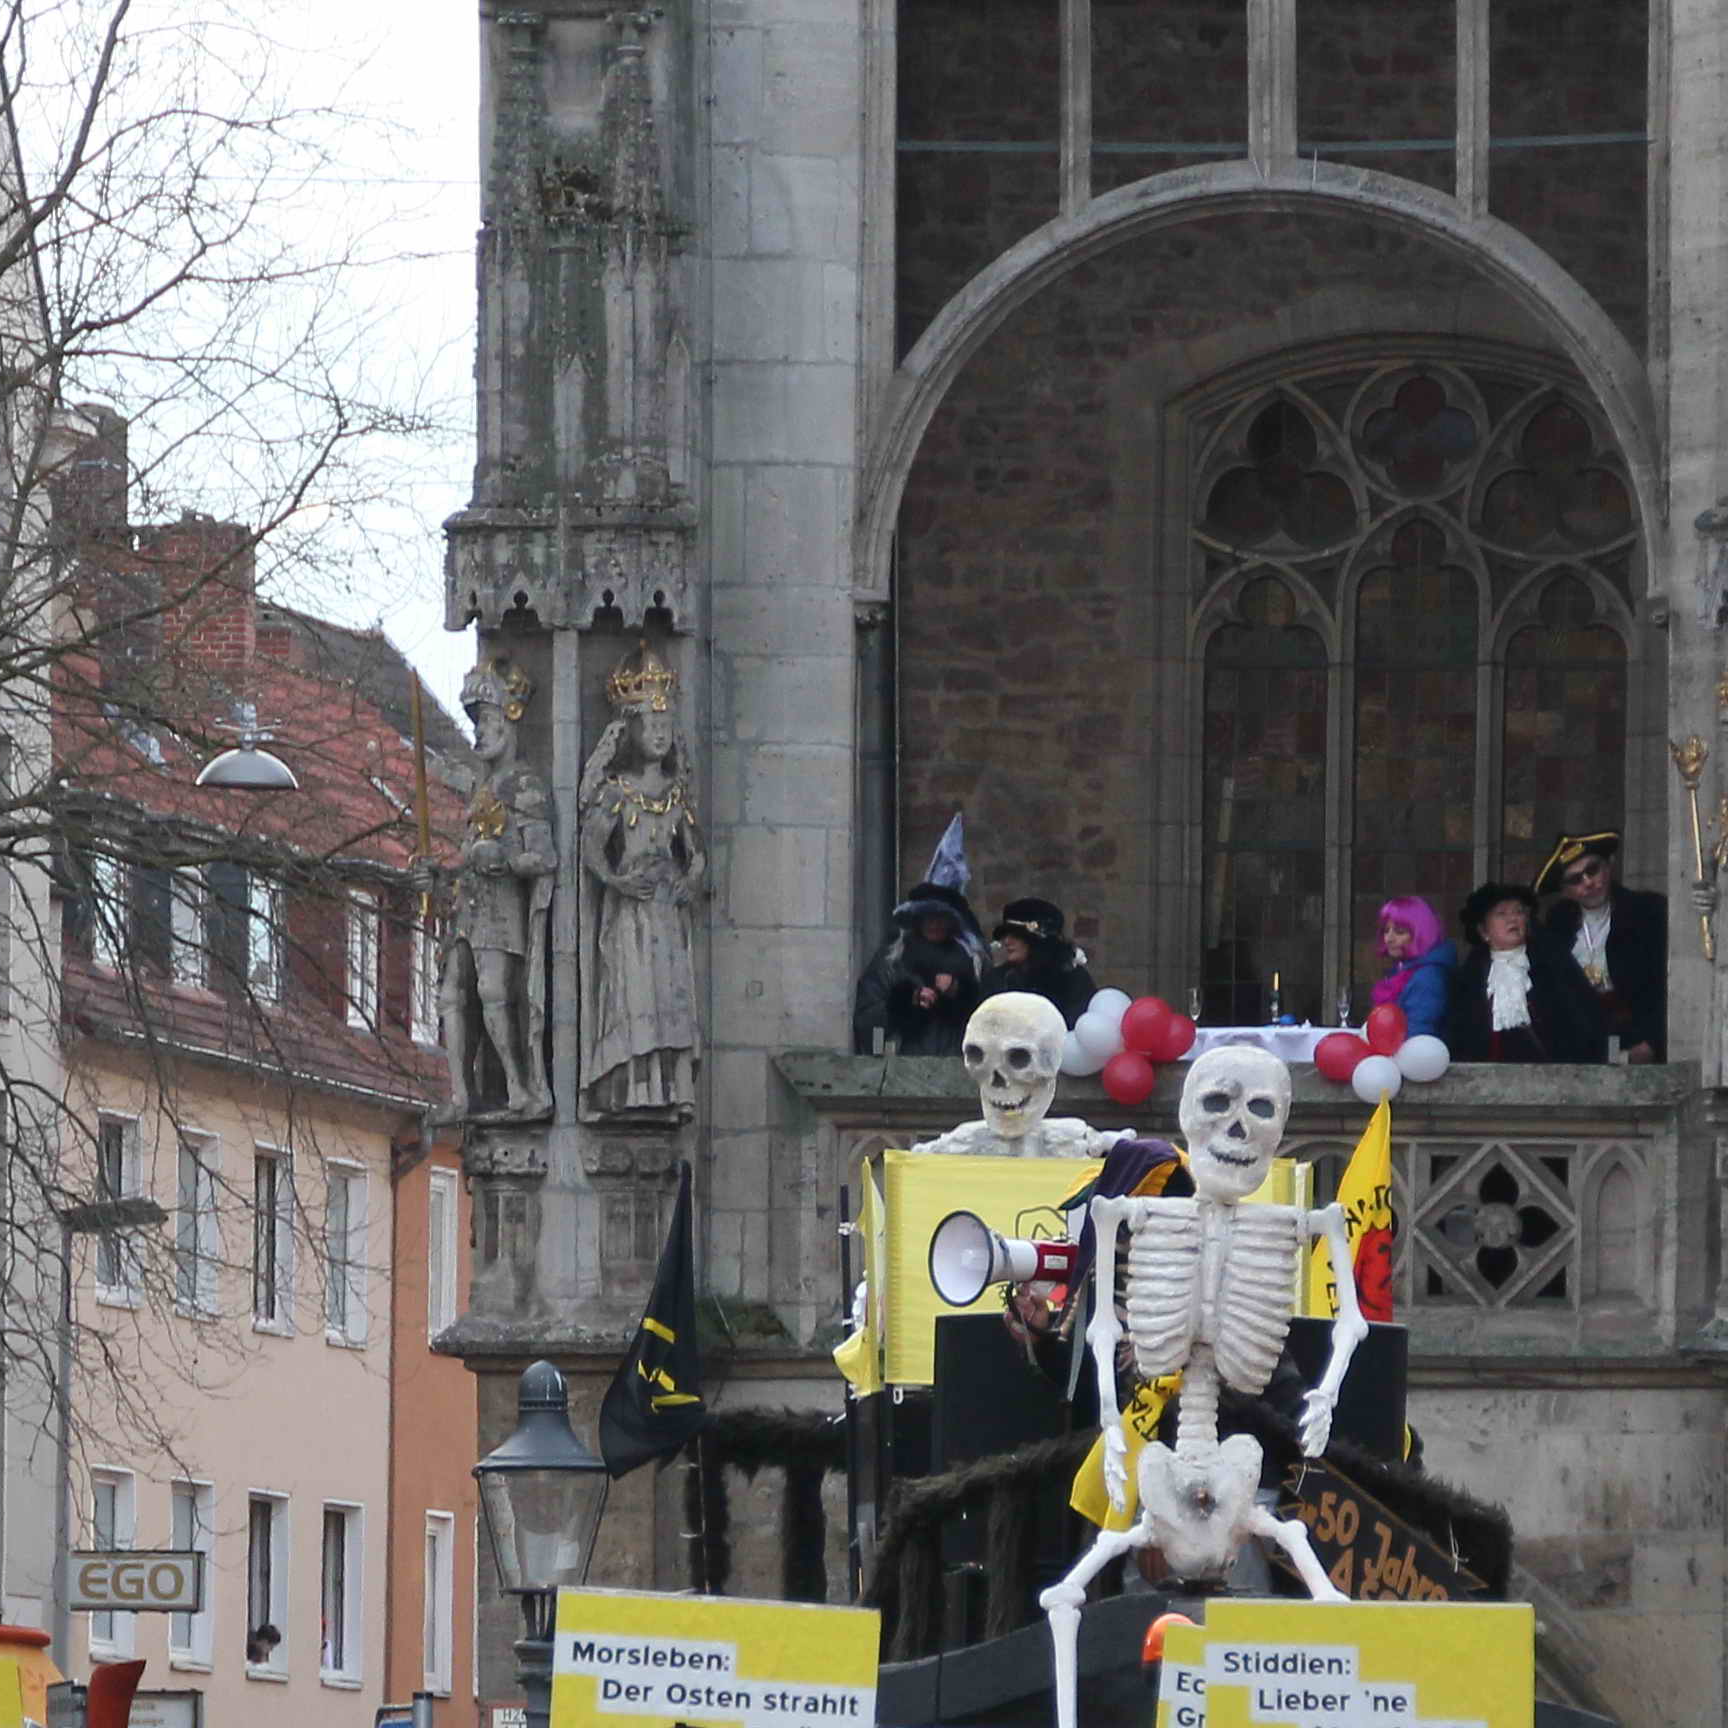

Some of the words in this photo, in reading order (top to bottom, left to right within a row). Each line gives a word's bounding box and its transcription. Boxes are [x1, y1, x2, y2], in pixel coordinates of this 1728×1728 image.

[78, 1563, 184, 1600] EGO
[572, 1641, 731, 1671] Morsleben:
[1223, 1652, 1352, 1676] Stiddien:
[602, 1680, 653, 1702] Der
[666, 1684, 751, 1709] Osten
[763, 1693, 859, 1716] strahlt
[1258, 1689, 1351, 1712] Lieber
